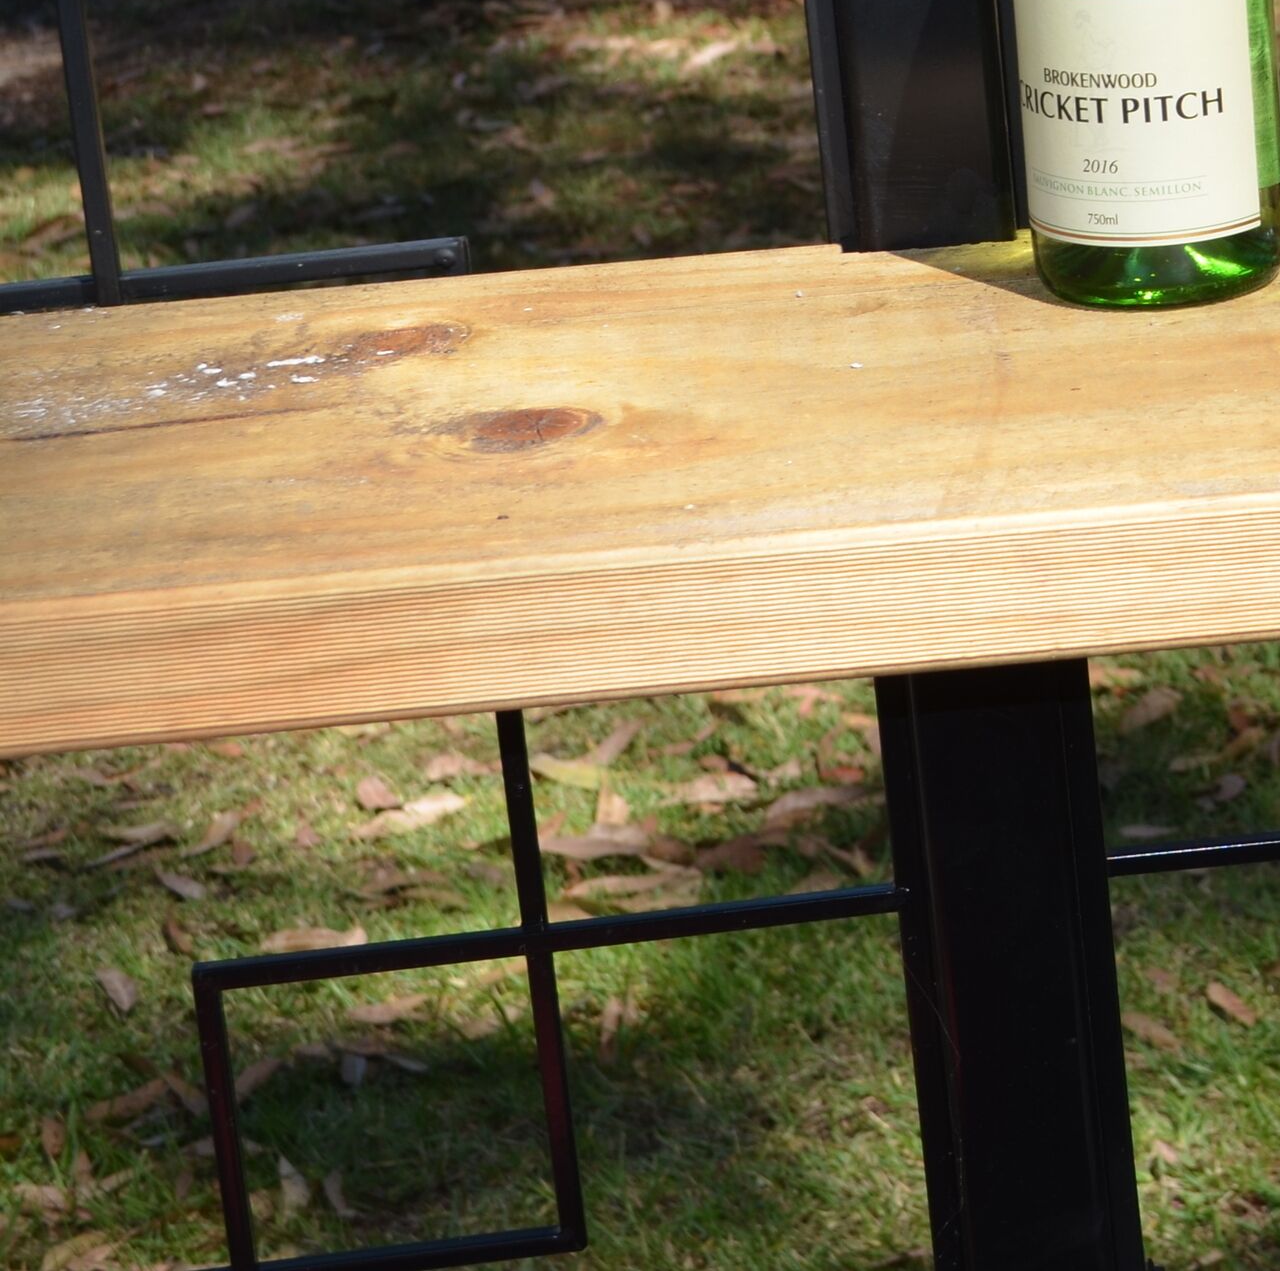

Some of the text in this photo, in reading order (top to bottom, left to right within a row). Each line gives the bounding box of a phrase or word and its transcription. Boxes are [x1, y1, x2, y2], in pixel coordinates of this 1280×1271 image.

[1043, 67, 1157, 89] BROKENWOOD
[1121, 87, 1223, 124] PITCH
[1082, 158, 1119, 174] 2016
[1134, 181, 1202, 197] SEMILLON
[1087, 213, 1119, 226] 750ml
